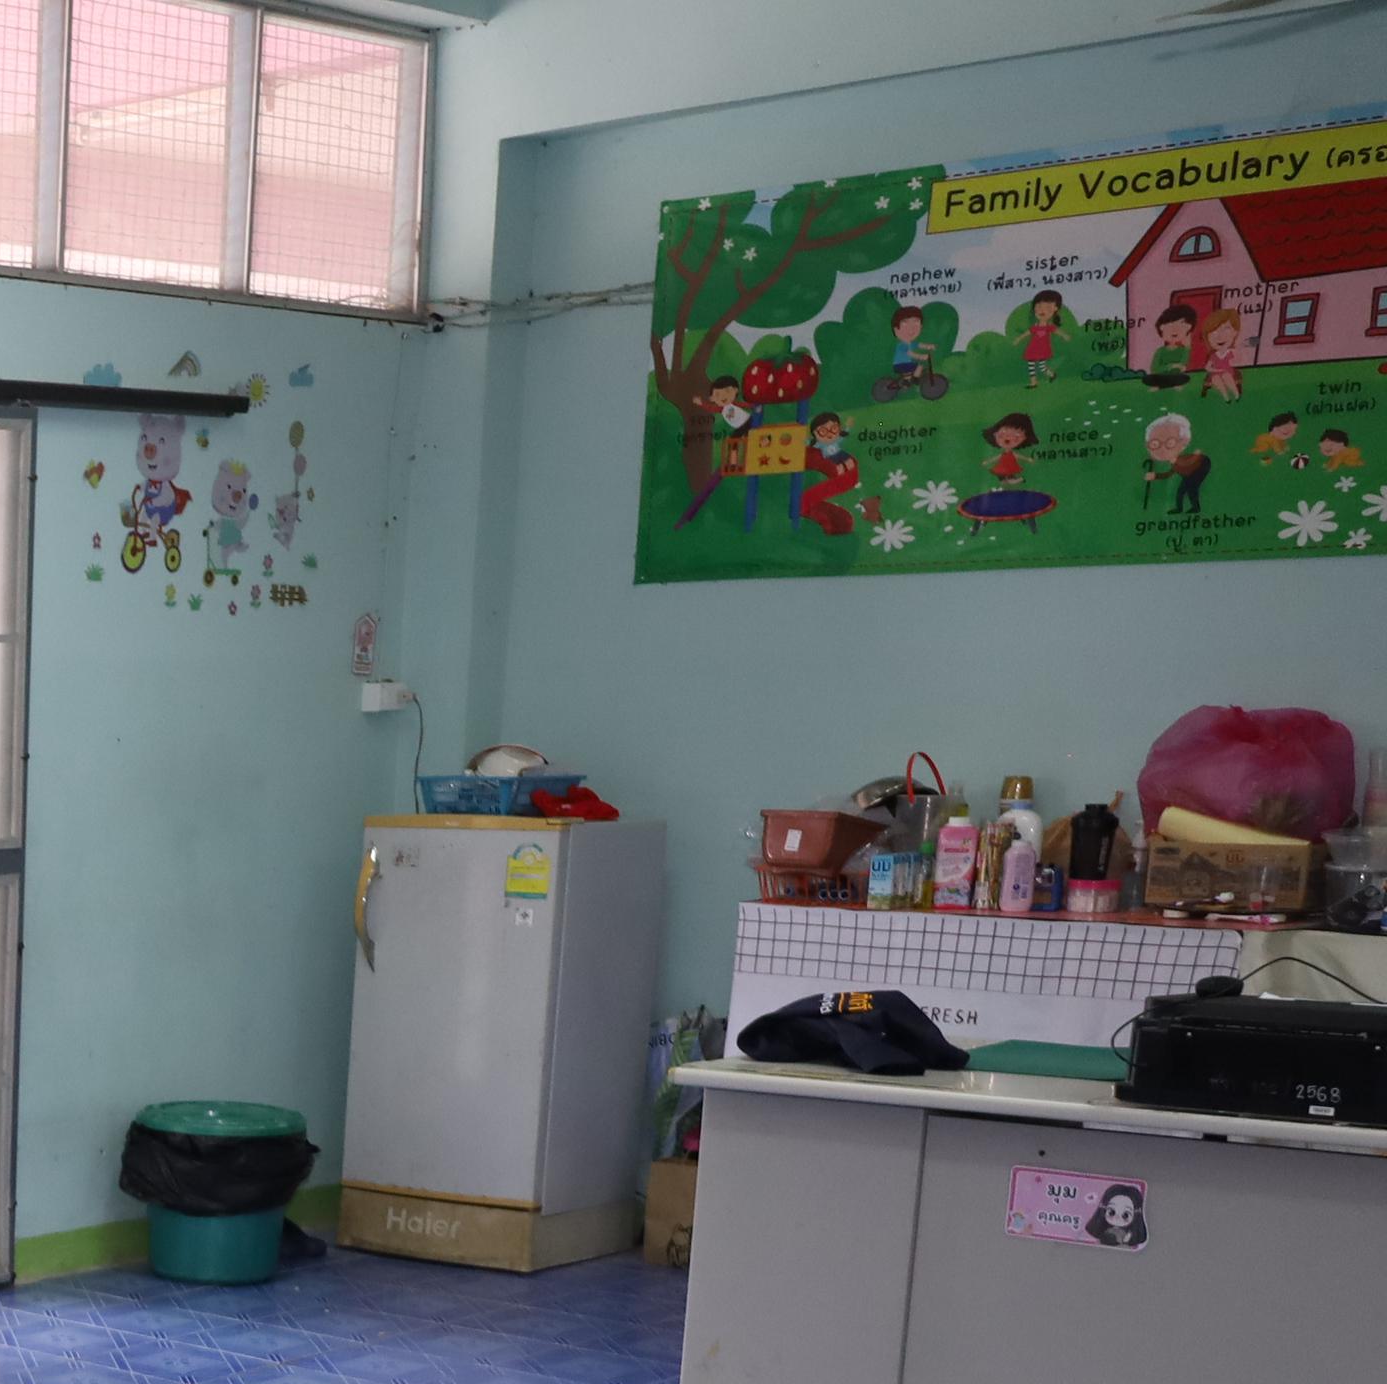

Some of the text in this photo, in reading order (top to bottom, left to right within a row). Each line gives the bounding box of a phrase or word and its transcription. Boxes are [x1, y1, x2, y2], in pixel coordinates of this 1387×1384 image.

[944, 149, 1310, 219] Family Vocabulary
[1026, 254, 1079, 271] sister
[890, 267, 957, 290] nephew
[1223, 280, 1300, 299] mother
[1084, 315, 1146, 333] father
[1317, 379, 1362, 396] twin
[857, 424, 938, 447] daughter
[1049, 427, 1099, 443] niece
[1134, 513, 1257, 536] grandfather
[1295, 1084, 1341, 1103] 2568
[1047, 1183, 1077, 1204] มุม
[385, 1206, 463, 1241] Haier
[1038, 1209, 1080, 1230] คุณครู
